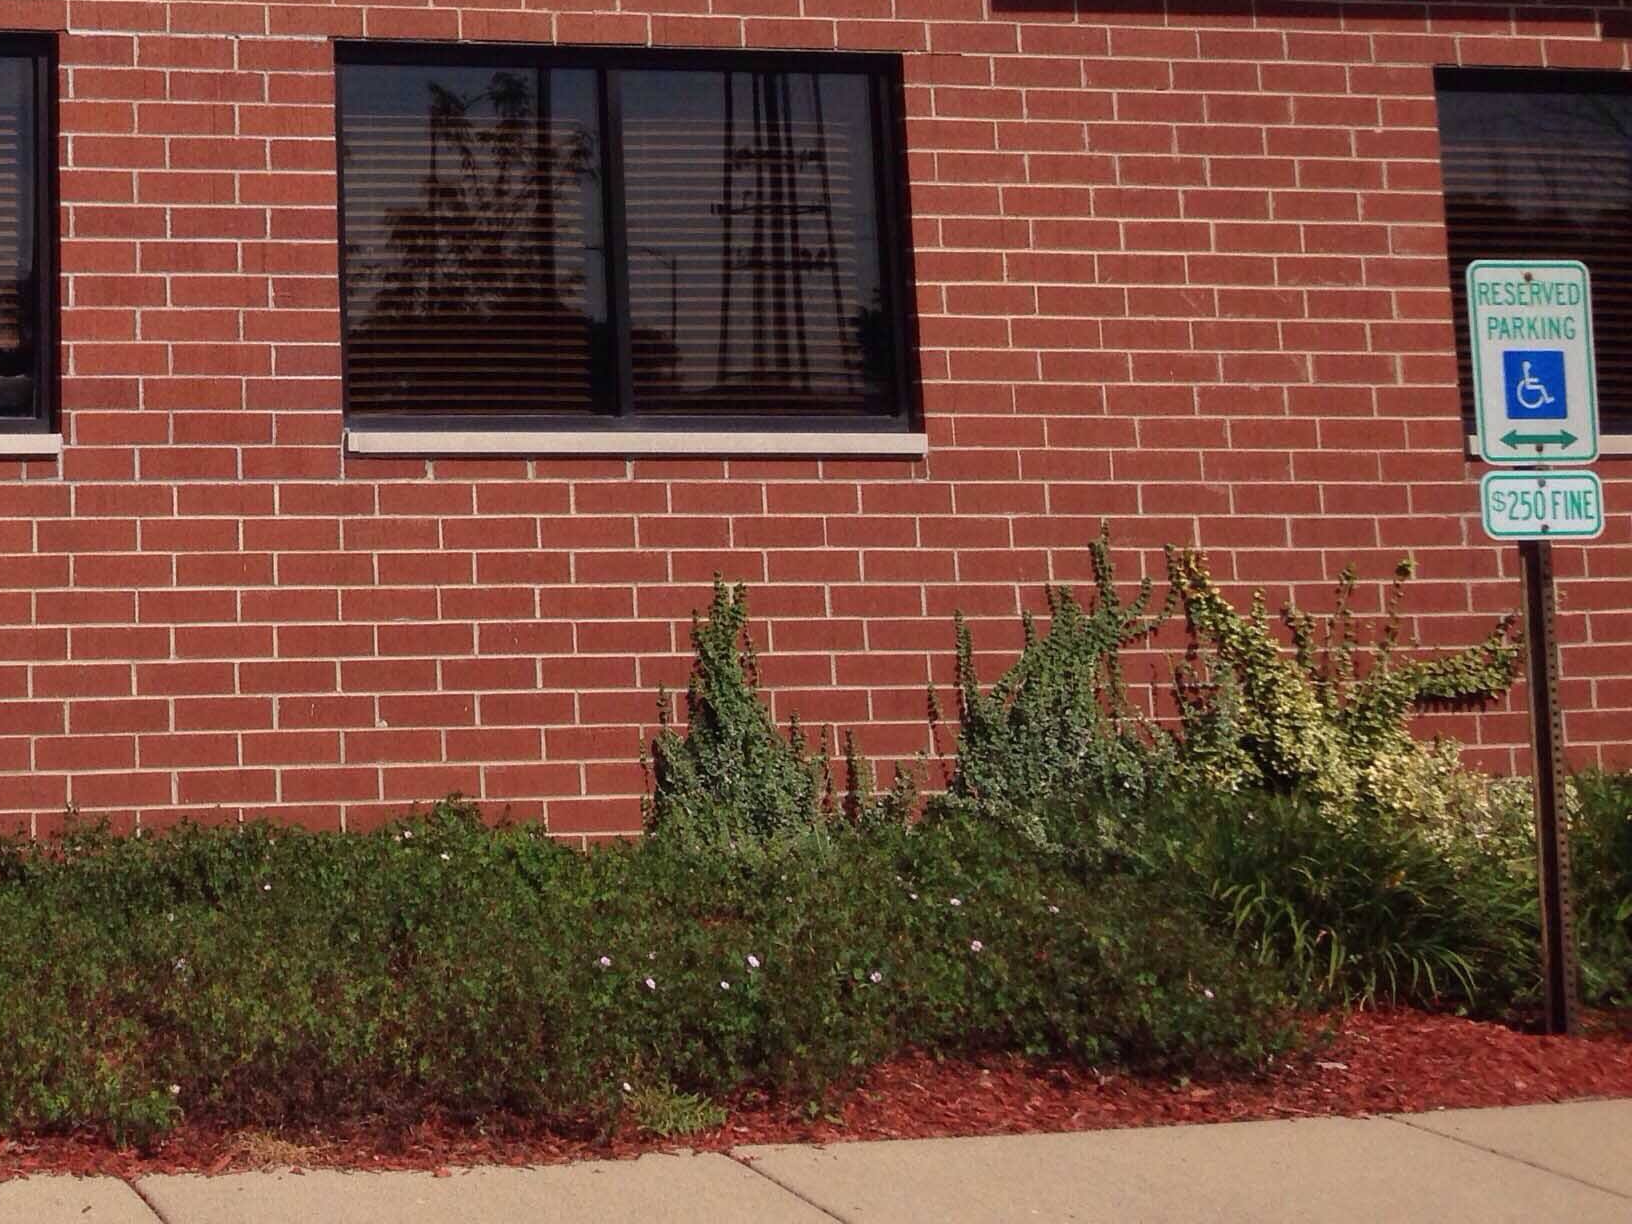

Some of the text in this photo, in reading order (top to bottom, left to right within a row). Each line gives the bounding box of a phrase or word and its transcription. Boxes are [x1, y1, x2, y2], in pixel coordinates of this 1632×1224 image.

[1478, 282, 1580, 306] RESERVED
[1487, 316, 1576, 340] PARKING
[1492, 491, 1595, 520] $250 FINE
